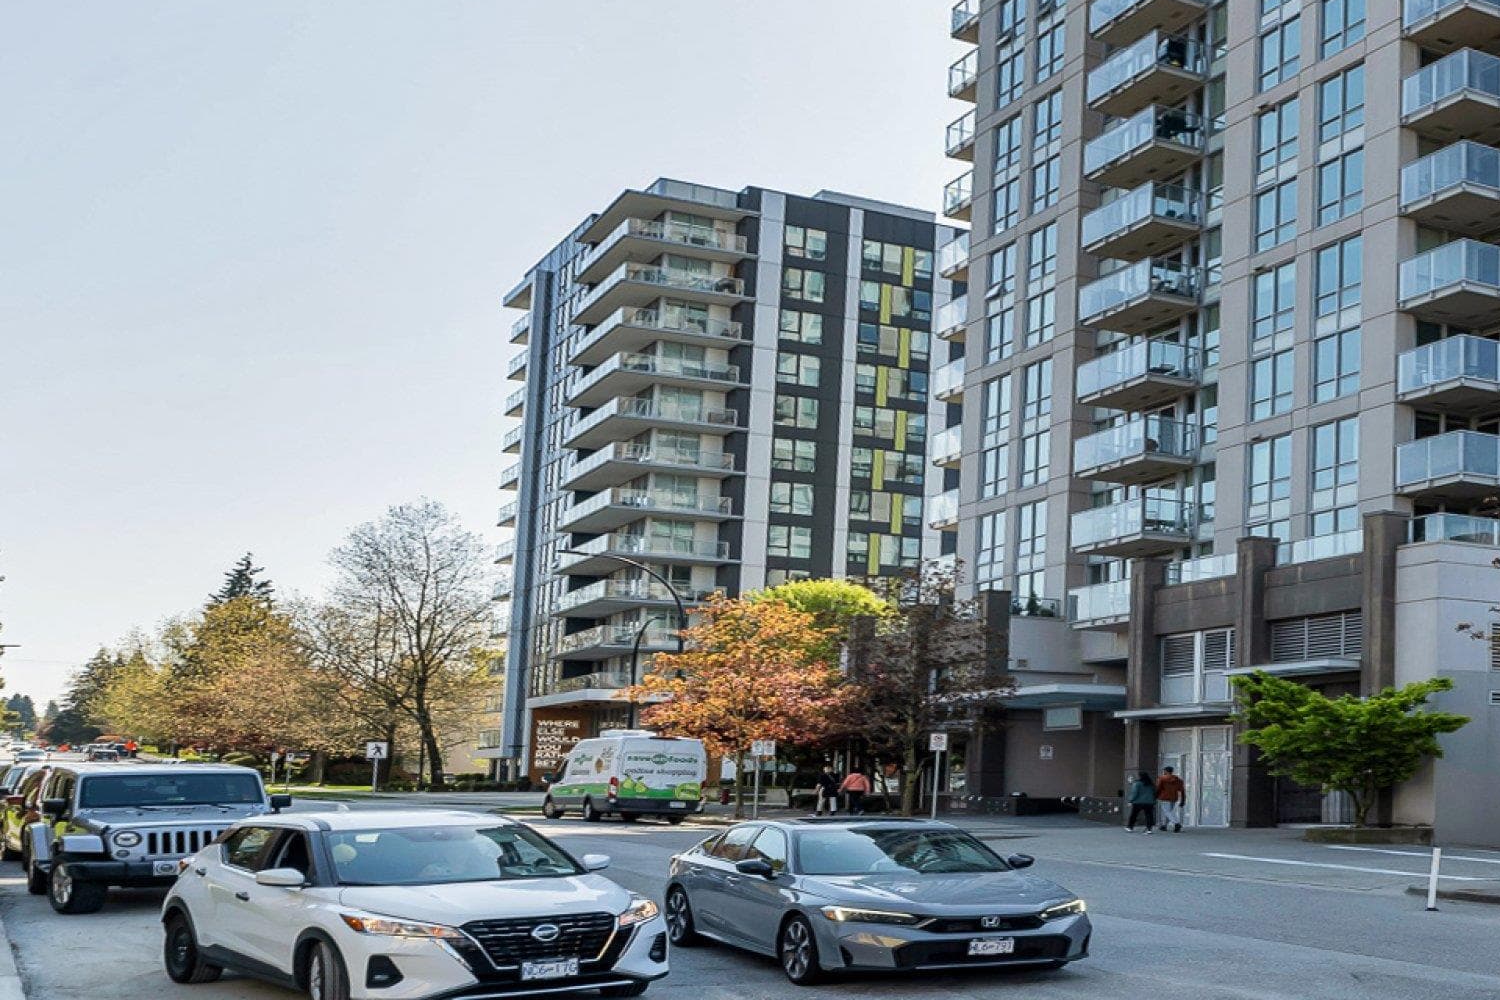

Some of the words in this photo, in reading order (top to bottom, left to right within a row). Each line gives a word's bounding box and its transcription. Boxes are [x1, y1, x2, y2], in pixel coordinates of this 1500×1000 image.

[536, 719, 580, 729] WHERE
[536, 727, 566, 736] ELSE
[536, 735, 581, 744] WOULD
[536, 743, 562, 751] YOU
[535, 750, 565, 759] RATH
